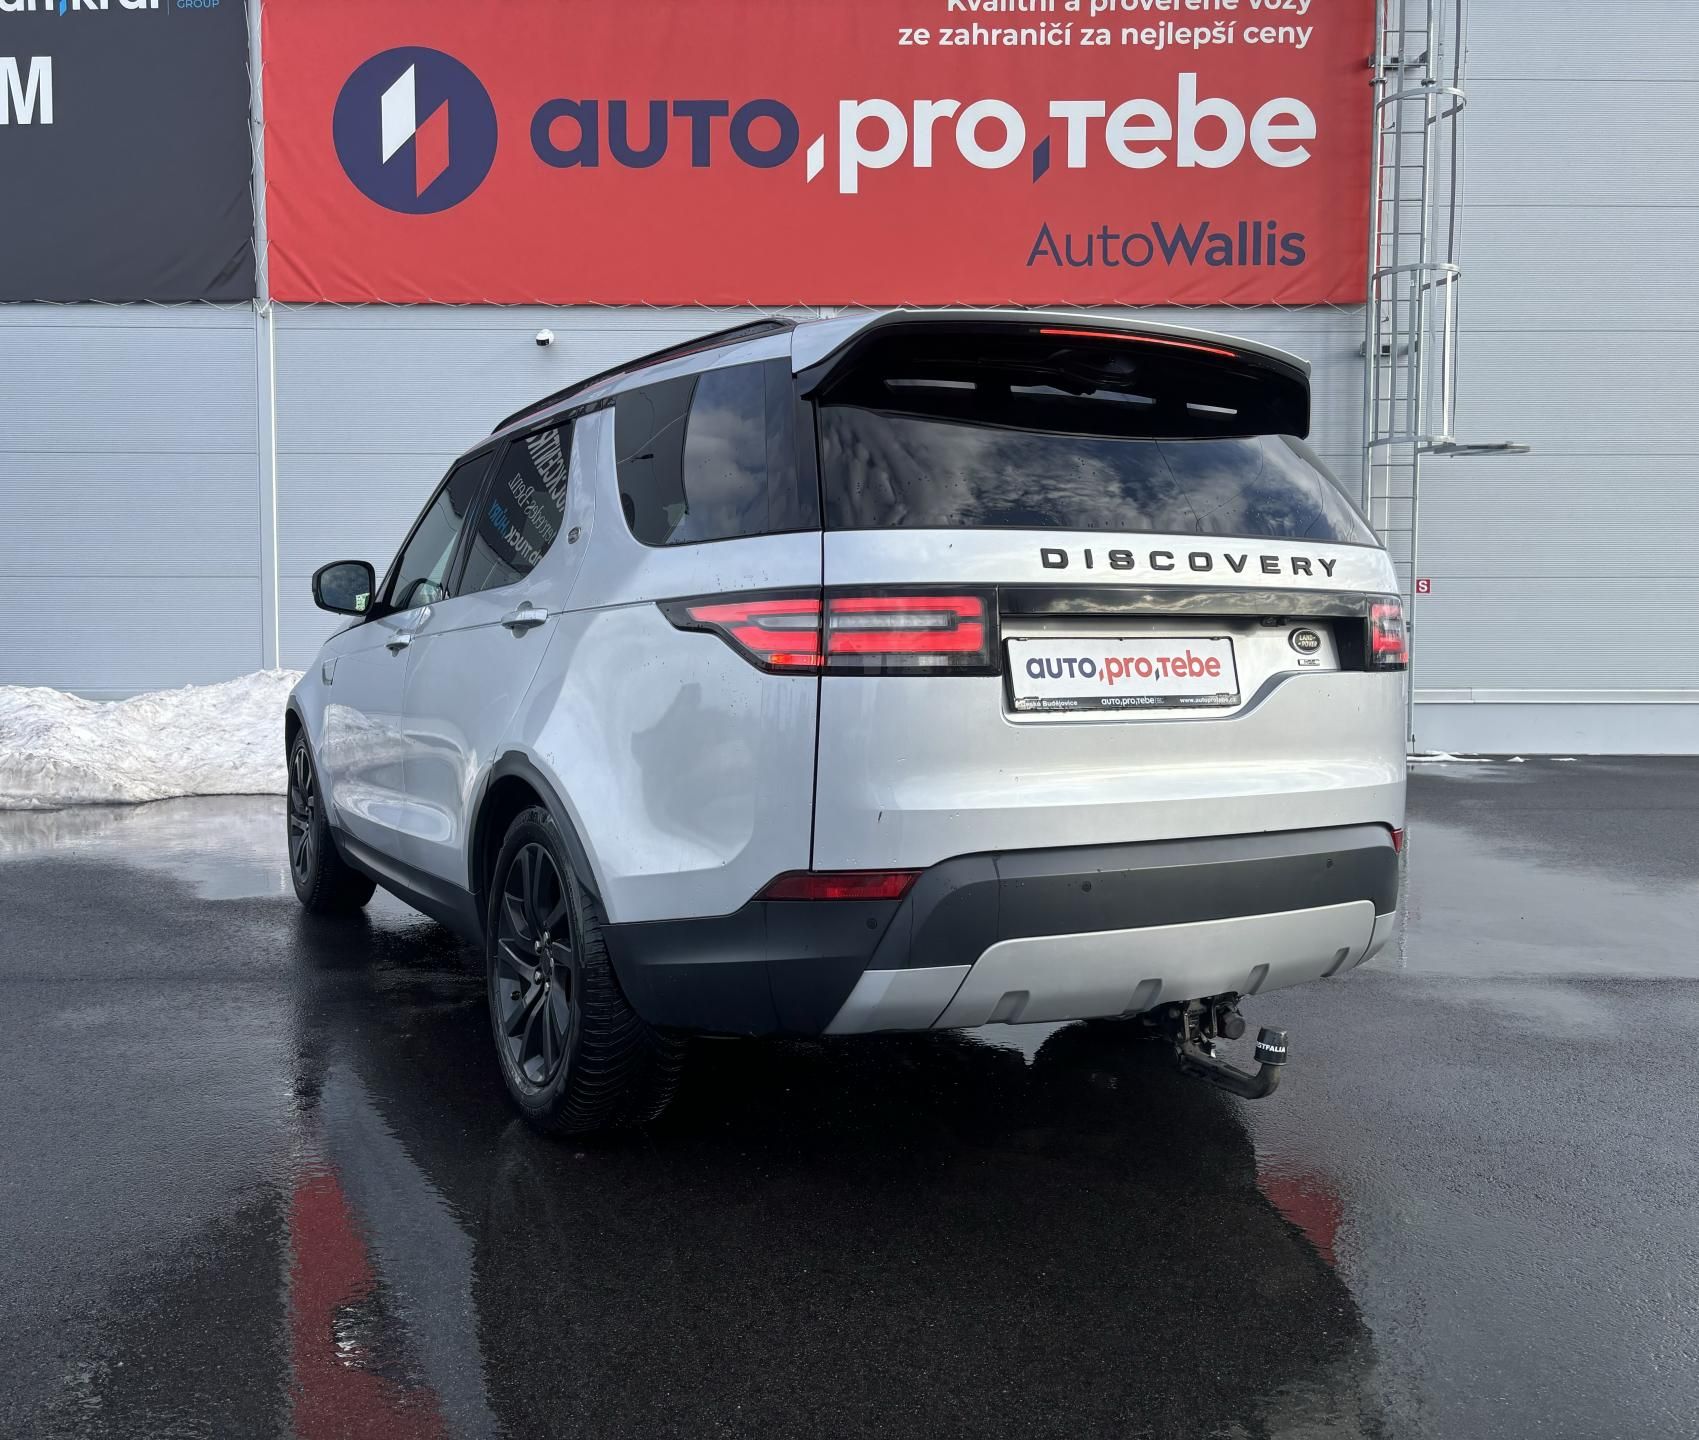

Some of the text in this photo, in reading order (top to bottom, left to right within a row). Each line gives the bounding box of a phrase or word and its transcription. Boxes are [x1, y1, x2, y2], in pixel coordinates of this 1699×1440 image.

[1064, 0, 1080, 12] a
[1250, 0, 1312, 15] vozy
[898, 20, 1314, 50] ze zahraničí za nejlepší ceny
[0, 55, 54, 125] M
[1026, 220, 1306, 267] AutoWallis
[1040, 547, 1338, 577] DISCOVERY
[1418, 580, 1428, 592] S
